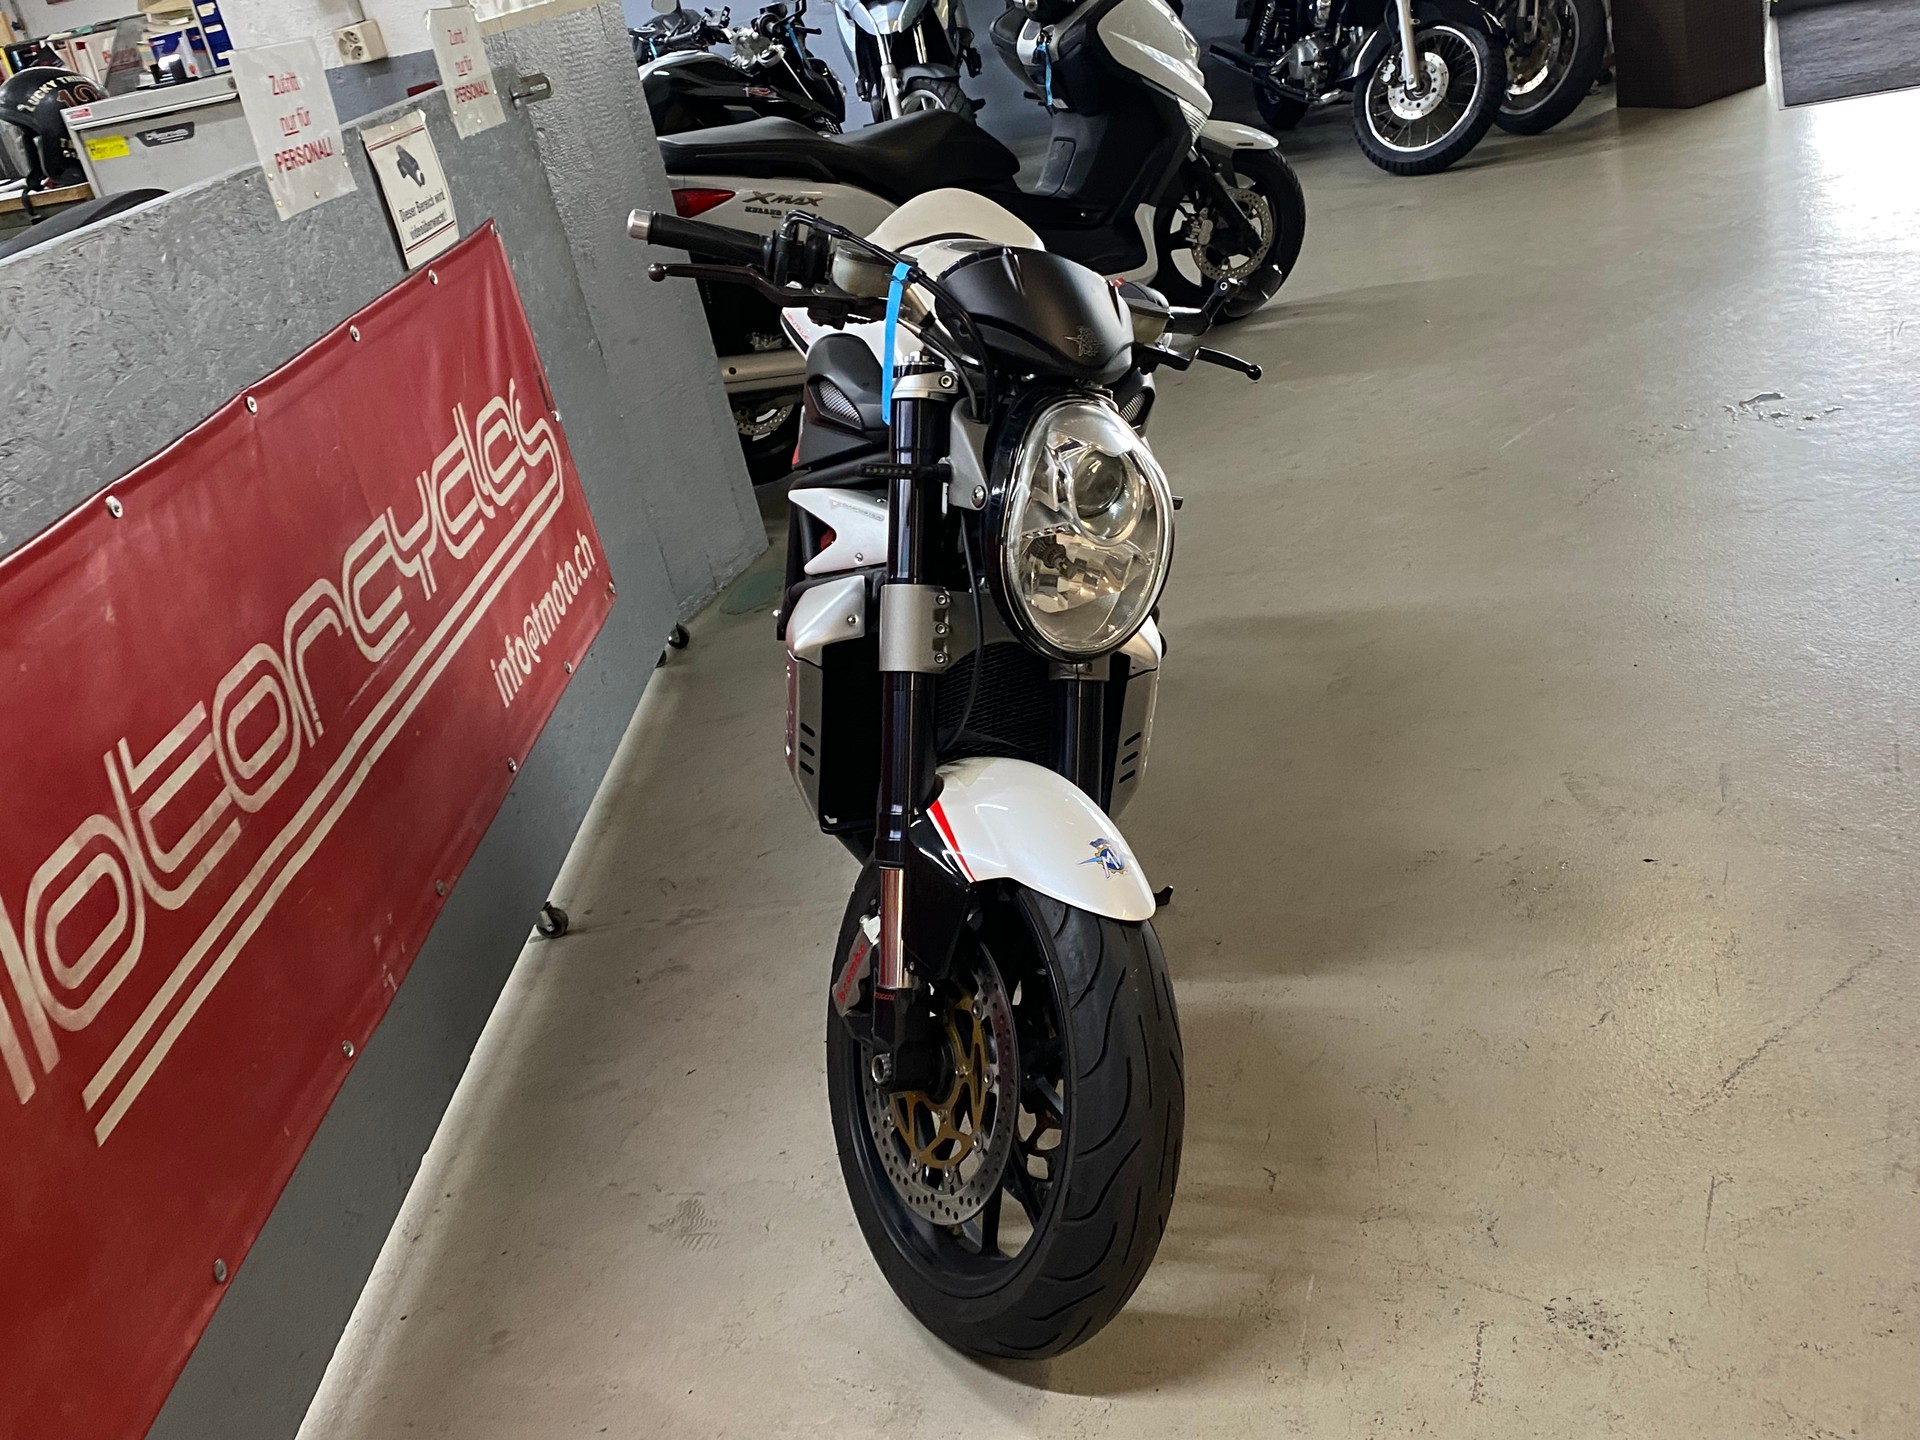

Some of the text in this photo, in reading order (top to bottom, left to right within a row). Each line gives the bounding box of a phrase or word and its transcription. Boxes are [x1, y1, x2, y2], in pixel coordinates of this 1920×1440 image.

[17, 80, 58, 112] LUCKY
[490, 528, 597, 709] info@tmoto.ch
[0, 377, 565, 1106] otorcycles
